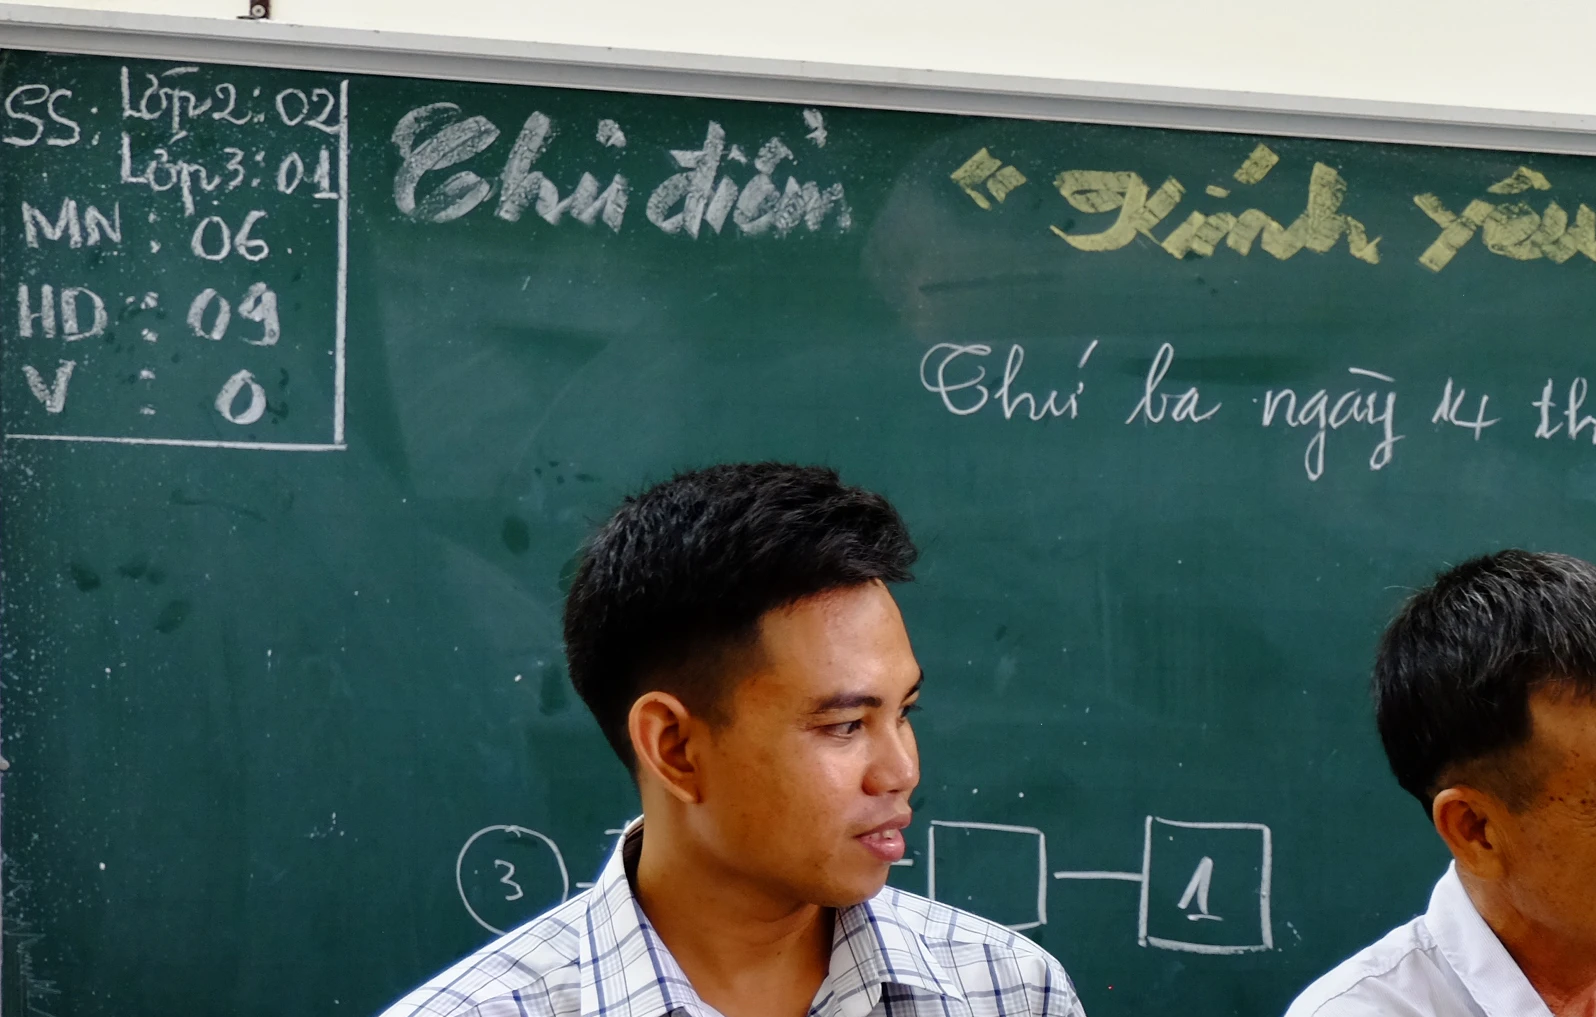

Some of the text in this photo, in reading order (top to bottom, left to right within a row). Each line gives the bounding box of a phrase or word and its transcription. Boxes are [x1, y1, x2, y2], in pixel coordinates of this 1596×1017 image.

[191, 209, 269, 261] 06
[187, 282, 280, 345] 09
[216, 370, 266, 424] 0
[920, 340, 1098, 420] Thứ
[1126, 343, 1221, 424] ba
[1262, 367, 1404, 481] ngày
[1432, 378, 1497, 440] 14
[495, 859, 523, 900] 3
[1178, 856, 1222, 921] 1
